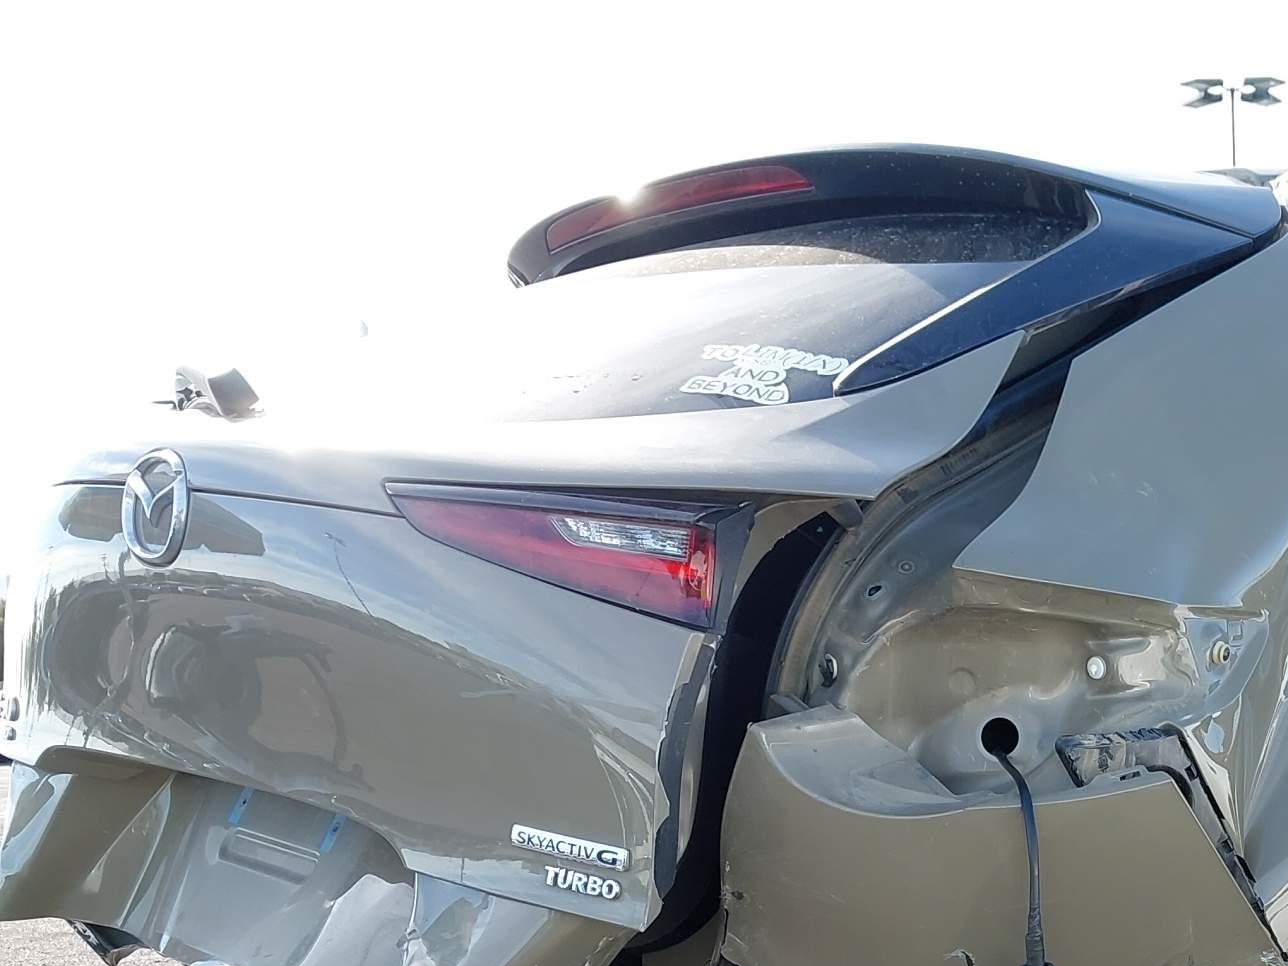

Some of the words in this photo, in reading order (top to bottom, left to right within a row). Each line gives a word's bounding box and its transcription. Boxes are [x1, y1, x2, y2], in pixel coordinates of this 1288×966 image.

[724, 367, 780, 383] AND
[687, 379, 786, 402] BEYOND
[544, 865, 622, 900] TURBO
